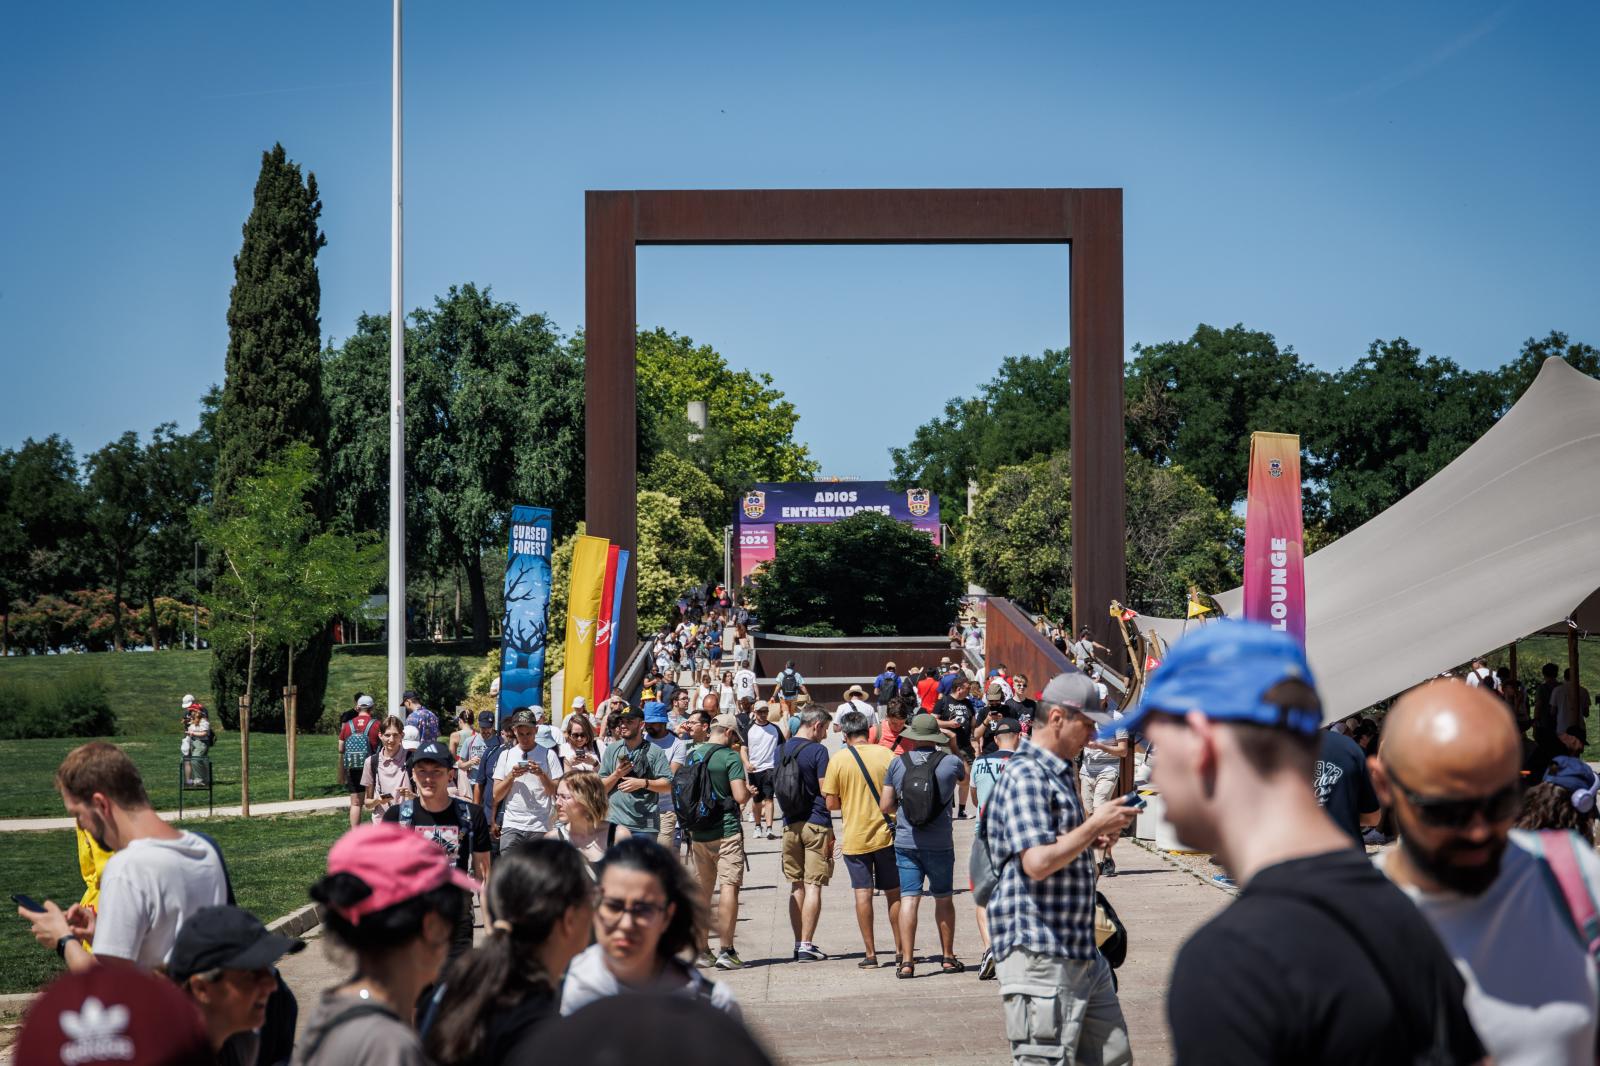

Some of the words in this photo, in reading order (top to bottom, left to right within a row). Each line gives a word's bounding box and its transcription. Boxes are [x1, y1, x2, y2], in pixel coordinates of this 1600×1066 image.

[814, 491, 858, 503] ADIOS
[513, 524, 547, 541] CURSED
[739, 535, 768, 545] 2024
[513, 540, 546, 556] FOREST
[1271, 537, 1287, 632] LOUNGE
[742, 677, 748, 688] 8
[976, 762, 993, 774] THE
